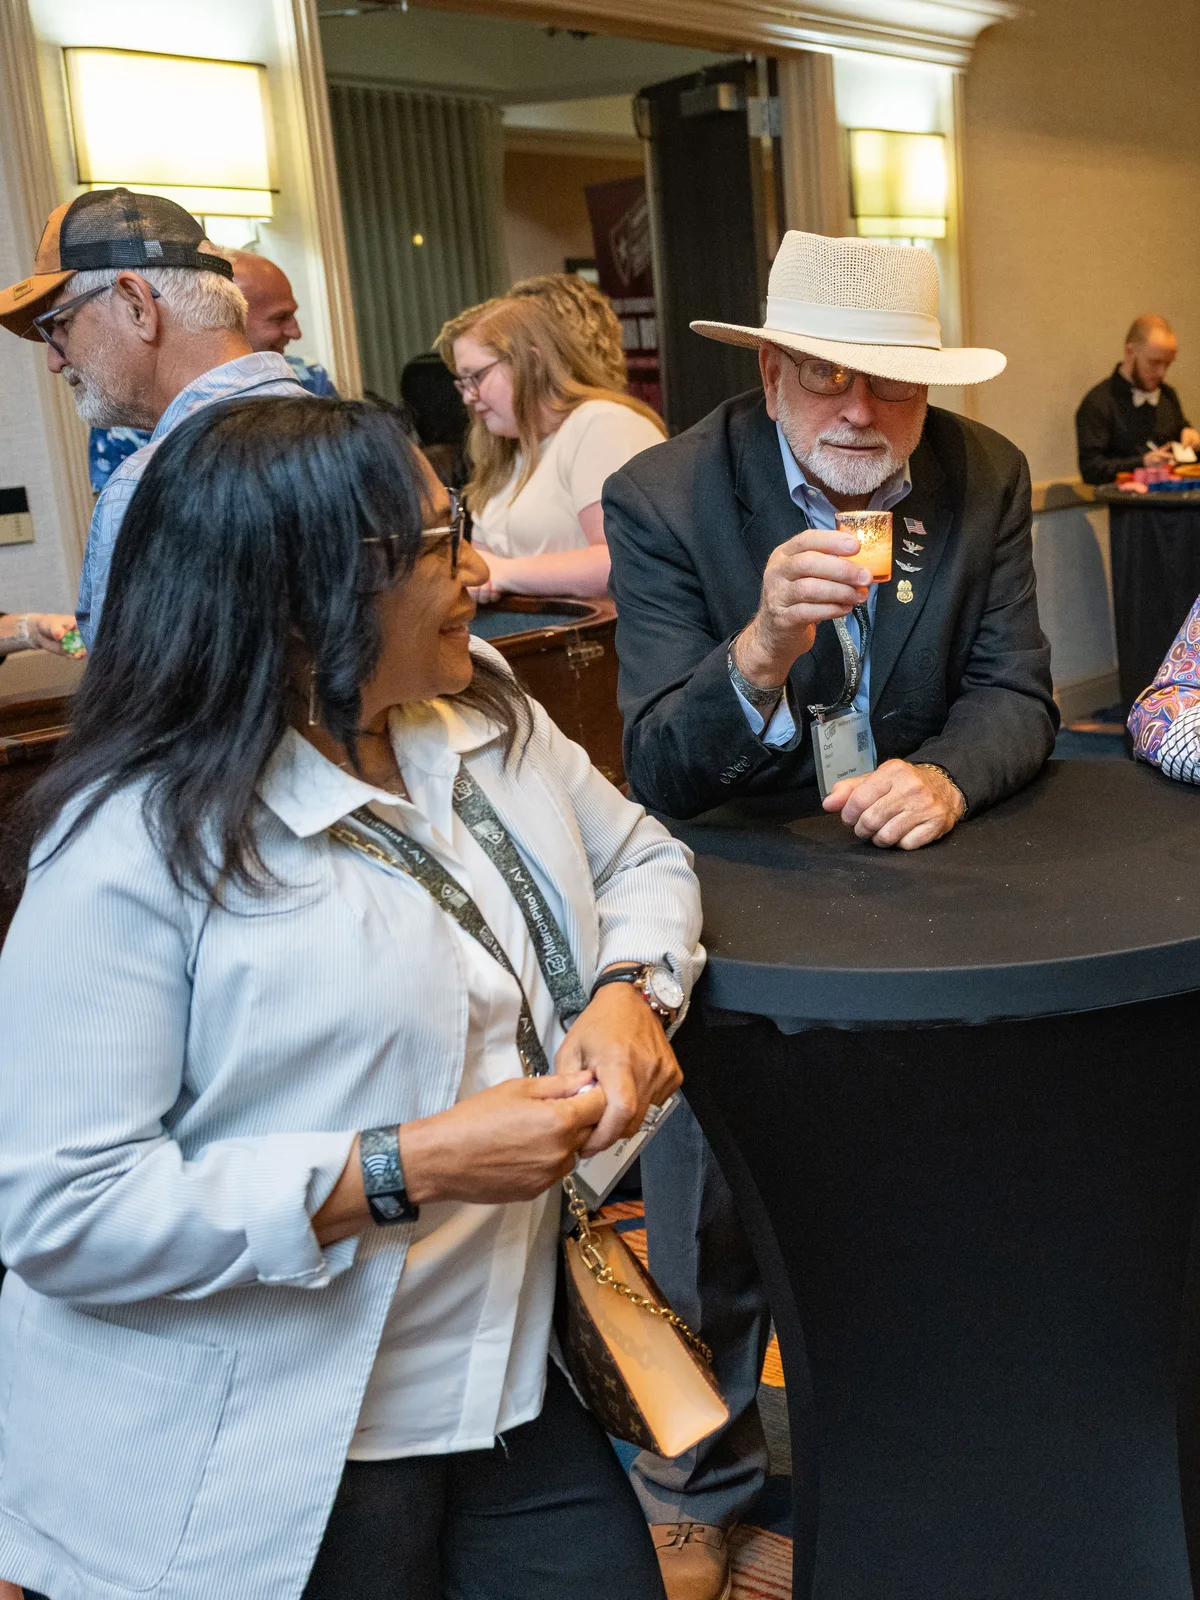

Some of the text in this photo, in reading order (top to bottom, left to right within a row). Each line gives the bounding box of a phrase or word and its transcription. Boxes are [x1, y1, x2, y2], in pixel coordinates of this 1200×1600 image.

[846, 641, 857, 687] MerchPilot
[510, 867, 558, 955] MerchPilot AI
